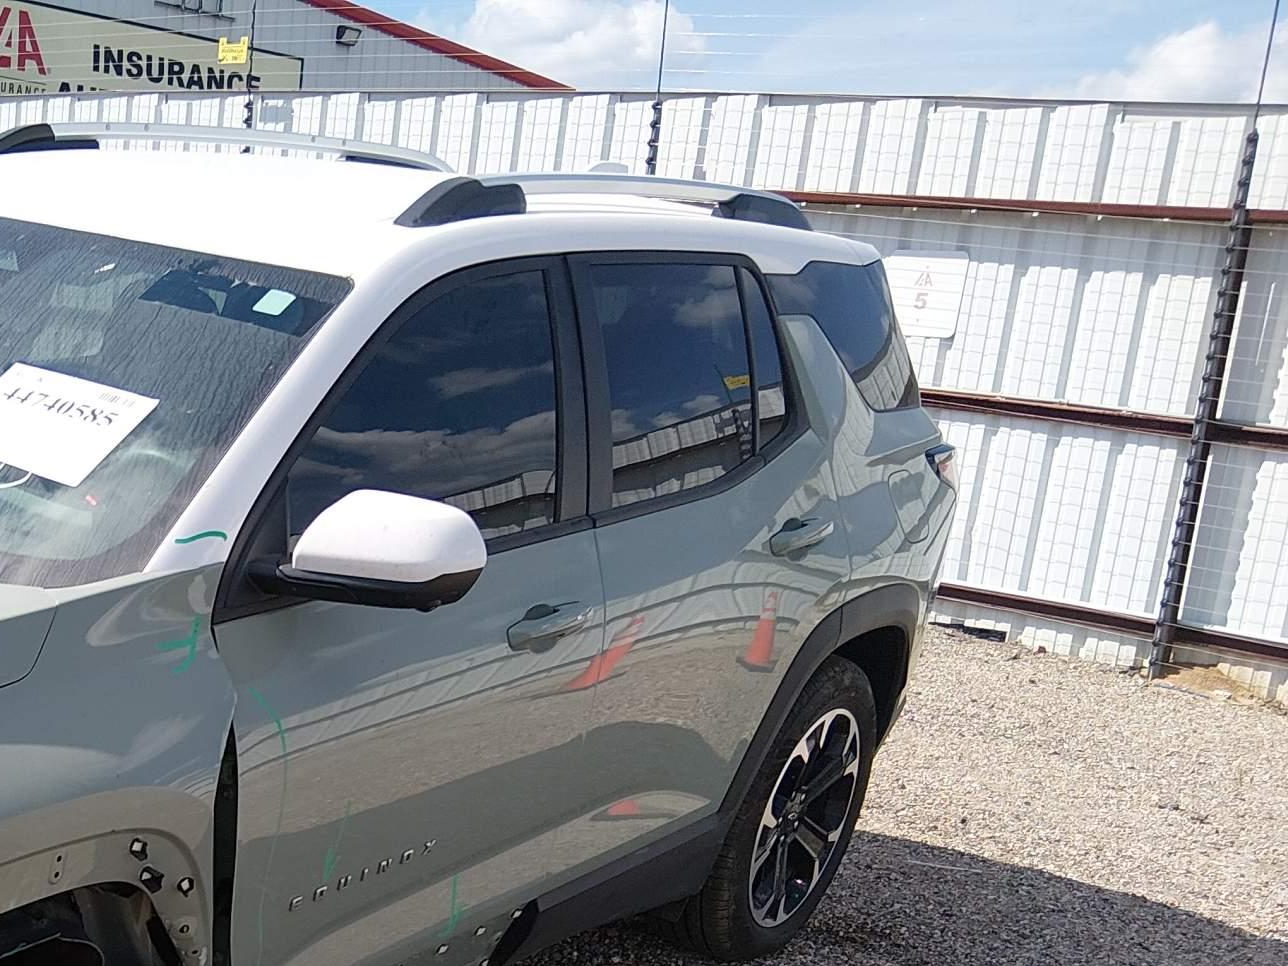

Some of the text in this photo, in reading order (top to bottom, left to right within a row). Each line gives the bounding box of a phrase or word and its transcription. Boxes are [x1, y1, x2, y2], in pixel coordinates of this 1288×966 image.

[913, 292, 929, 310] 5
[3, 387, 119, 426] 44740585
[288, 838, 437, 912] EQUINOX
